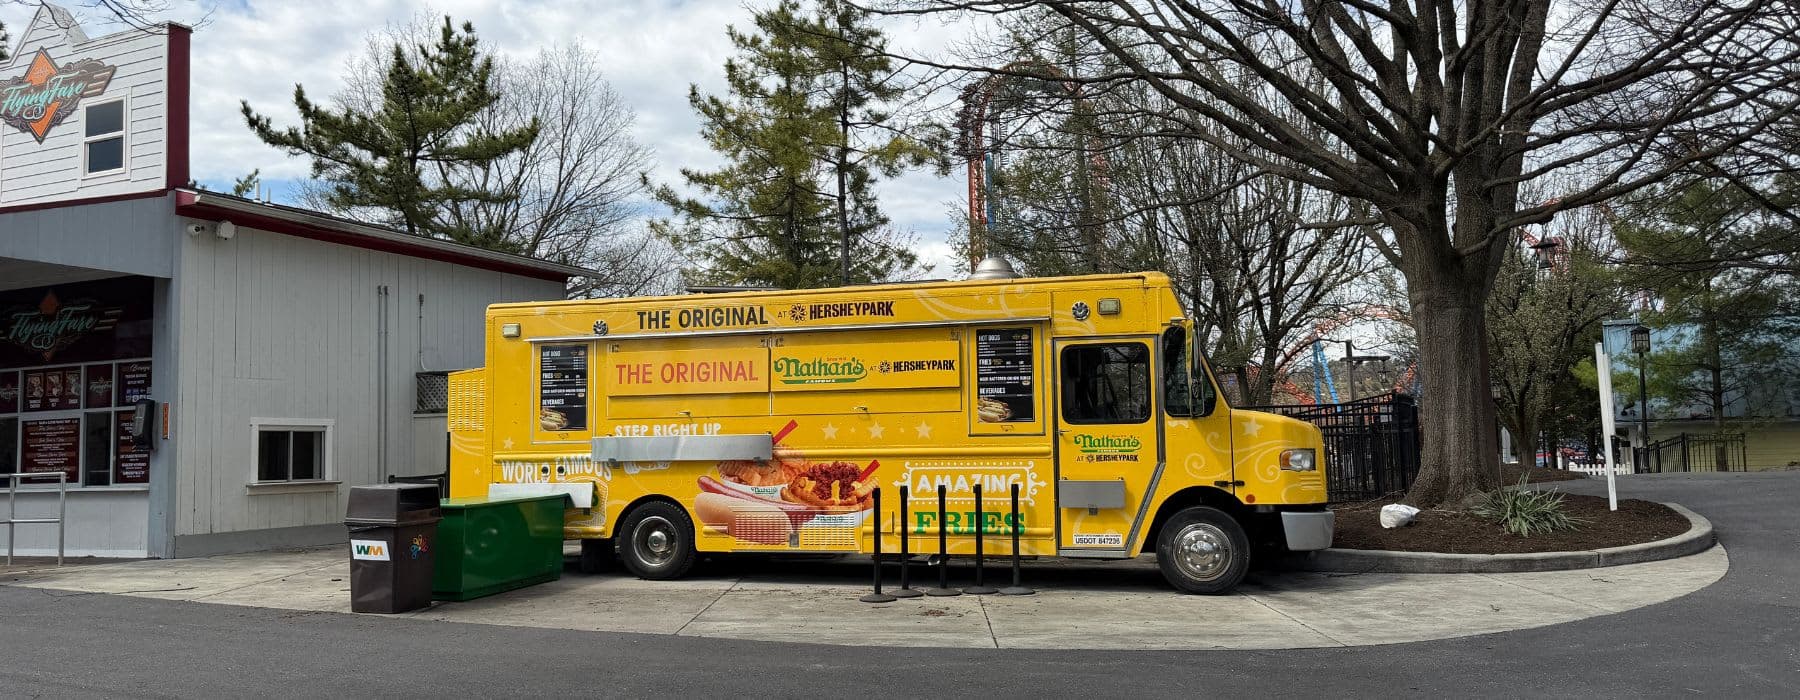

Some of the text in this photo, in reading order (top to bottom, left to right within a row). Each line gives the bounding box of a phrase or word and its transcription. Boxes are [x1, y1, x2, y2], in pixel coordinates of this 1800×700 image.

[637, 306, 769, 330] THE ORIGINAL
[778, 301, 895, 320] AT HERSHEYPARK
[616, 361, 759, 385] THE ORIGINAL
[773, 357, 866, 378] Nathan's
[893, 360, 956, 373] HERSHEYPARK
[615, 422, 721, 437] STEP RIGHT UP
[1074, 434, 1140, 448] Nathan's
[1096, 454, 1139, 462] HERSHEYPARK
[501, 460, 551, 484] WORLD
[915, 473, 1024, 494] AMAZING
[913, 511, 1026, 536] FRIES
[356, 545, 383, 556] WM
[1075, 537, 1096, 545] USDOT
